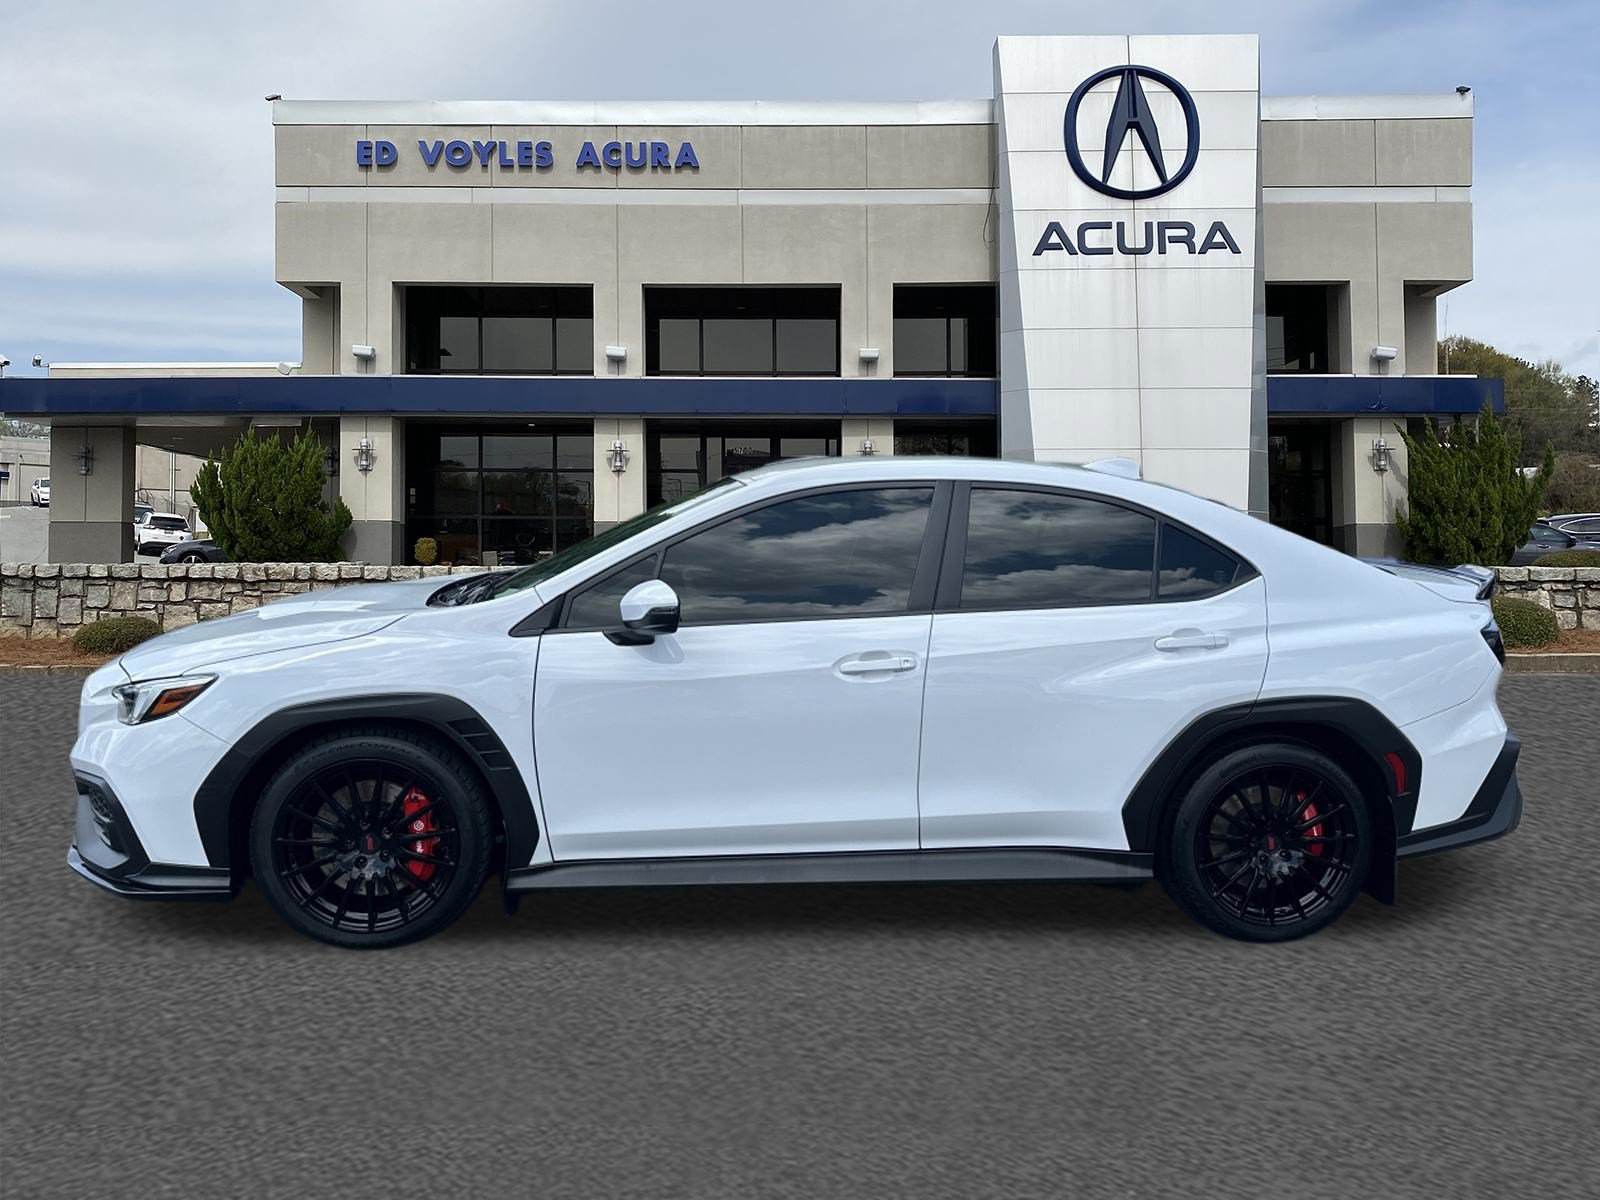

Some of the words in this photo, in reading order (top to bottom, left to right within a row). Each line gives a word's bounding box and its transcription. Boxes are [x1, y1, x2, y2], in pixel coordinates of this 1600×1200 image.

[356, 140, 398, 168] ED
[418, 140, 554, 168] VOYLES
[576, 141, 700, 169] ACURA
[1032, 221, 1242, 256] ACURA
